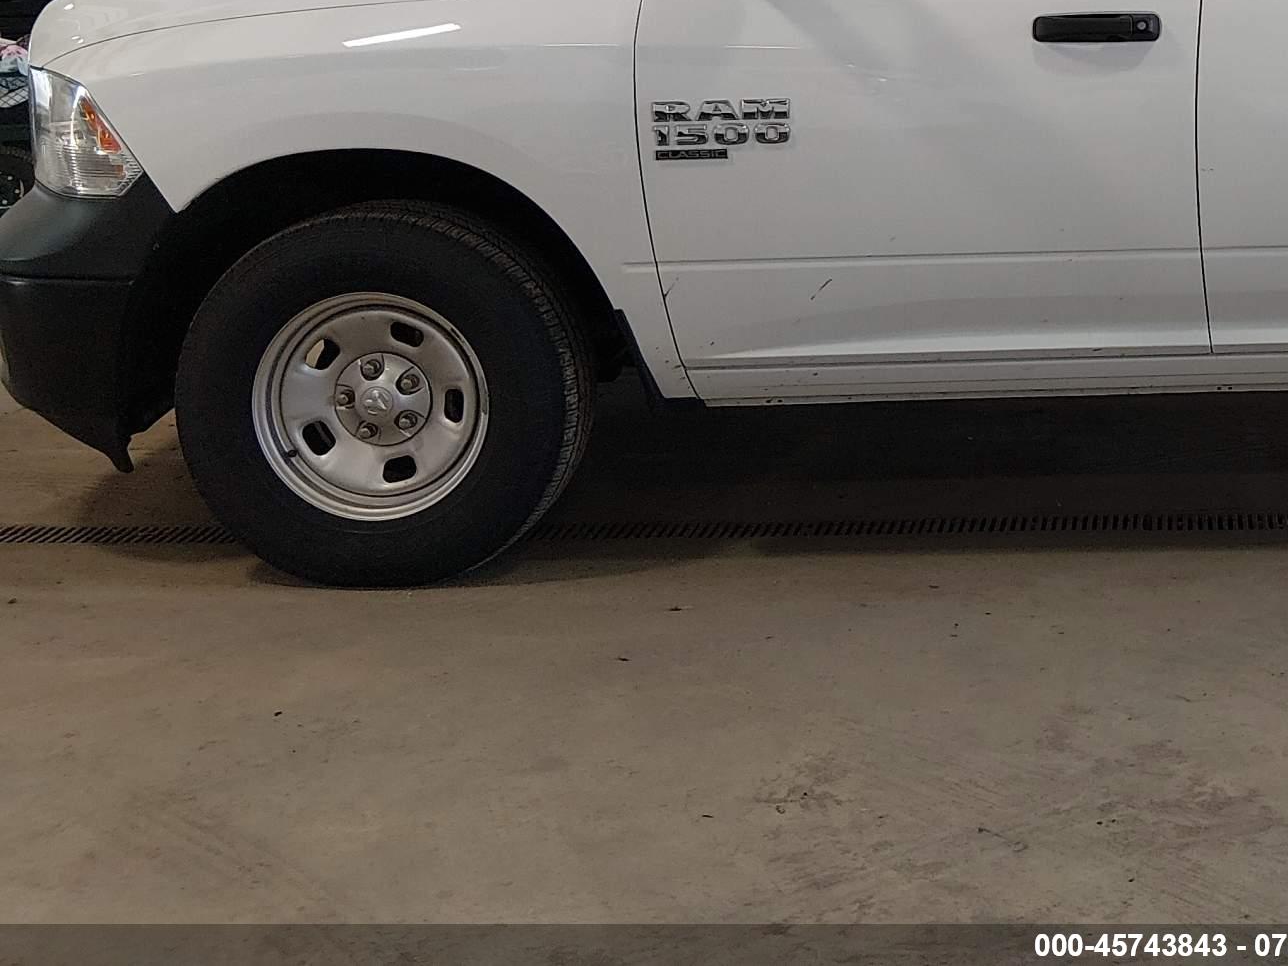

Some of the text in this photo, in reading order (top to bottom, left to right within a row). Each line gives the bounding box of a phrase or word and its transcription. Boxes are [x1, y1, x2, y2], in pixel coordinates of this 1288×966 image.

[652, 98, 790, 122] RAM
[653, 122, 791, 146] 1500
[656, 150, 728, 159] CLASSIC
